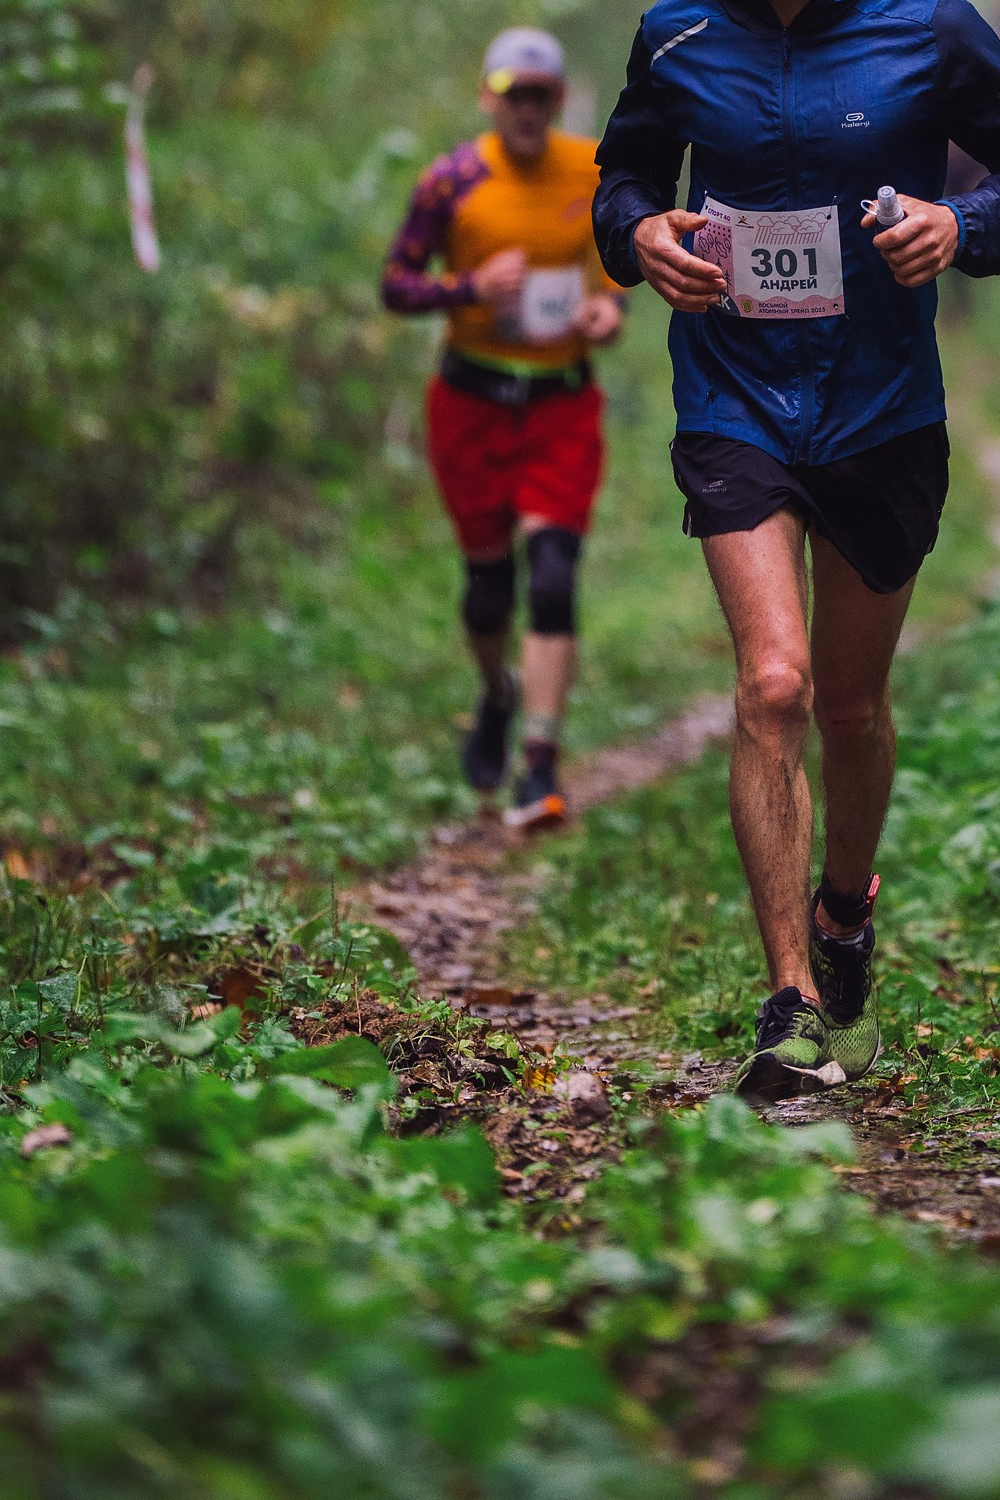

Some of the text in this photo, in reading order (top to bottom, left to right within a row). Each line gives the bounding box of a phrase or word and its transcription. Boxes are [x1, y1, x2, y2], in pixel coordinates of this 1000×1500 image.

[708, 208, 731, 222] СПОРТ 40
[751, 248, 817, 277] 301
[760, 276, 817, 291] АНДРЕЙ
